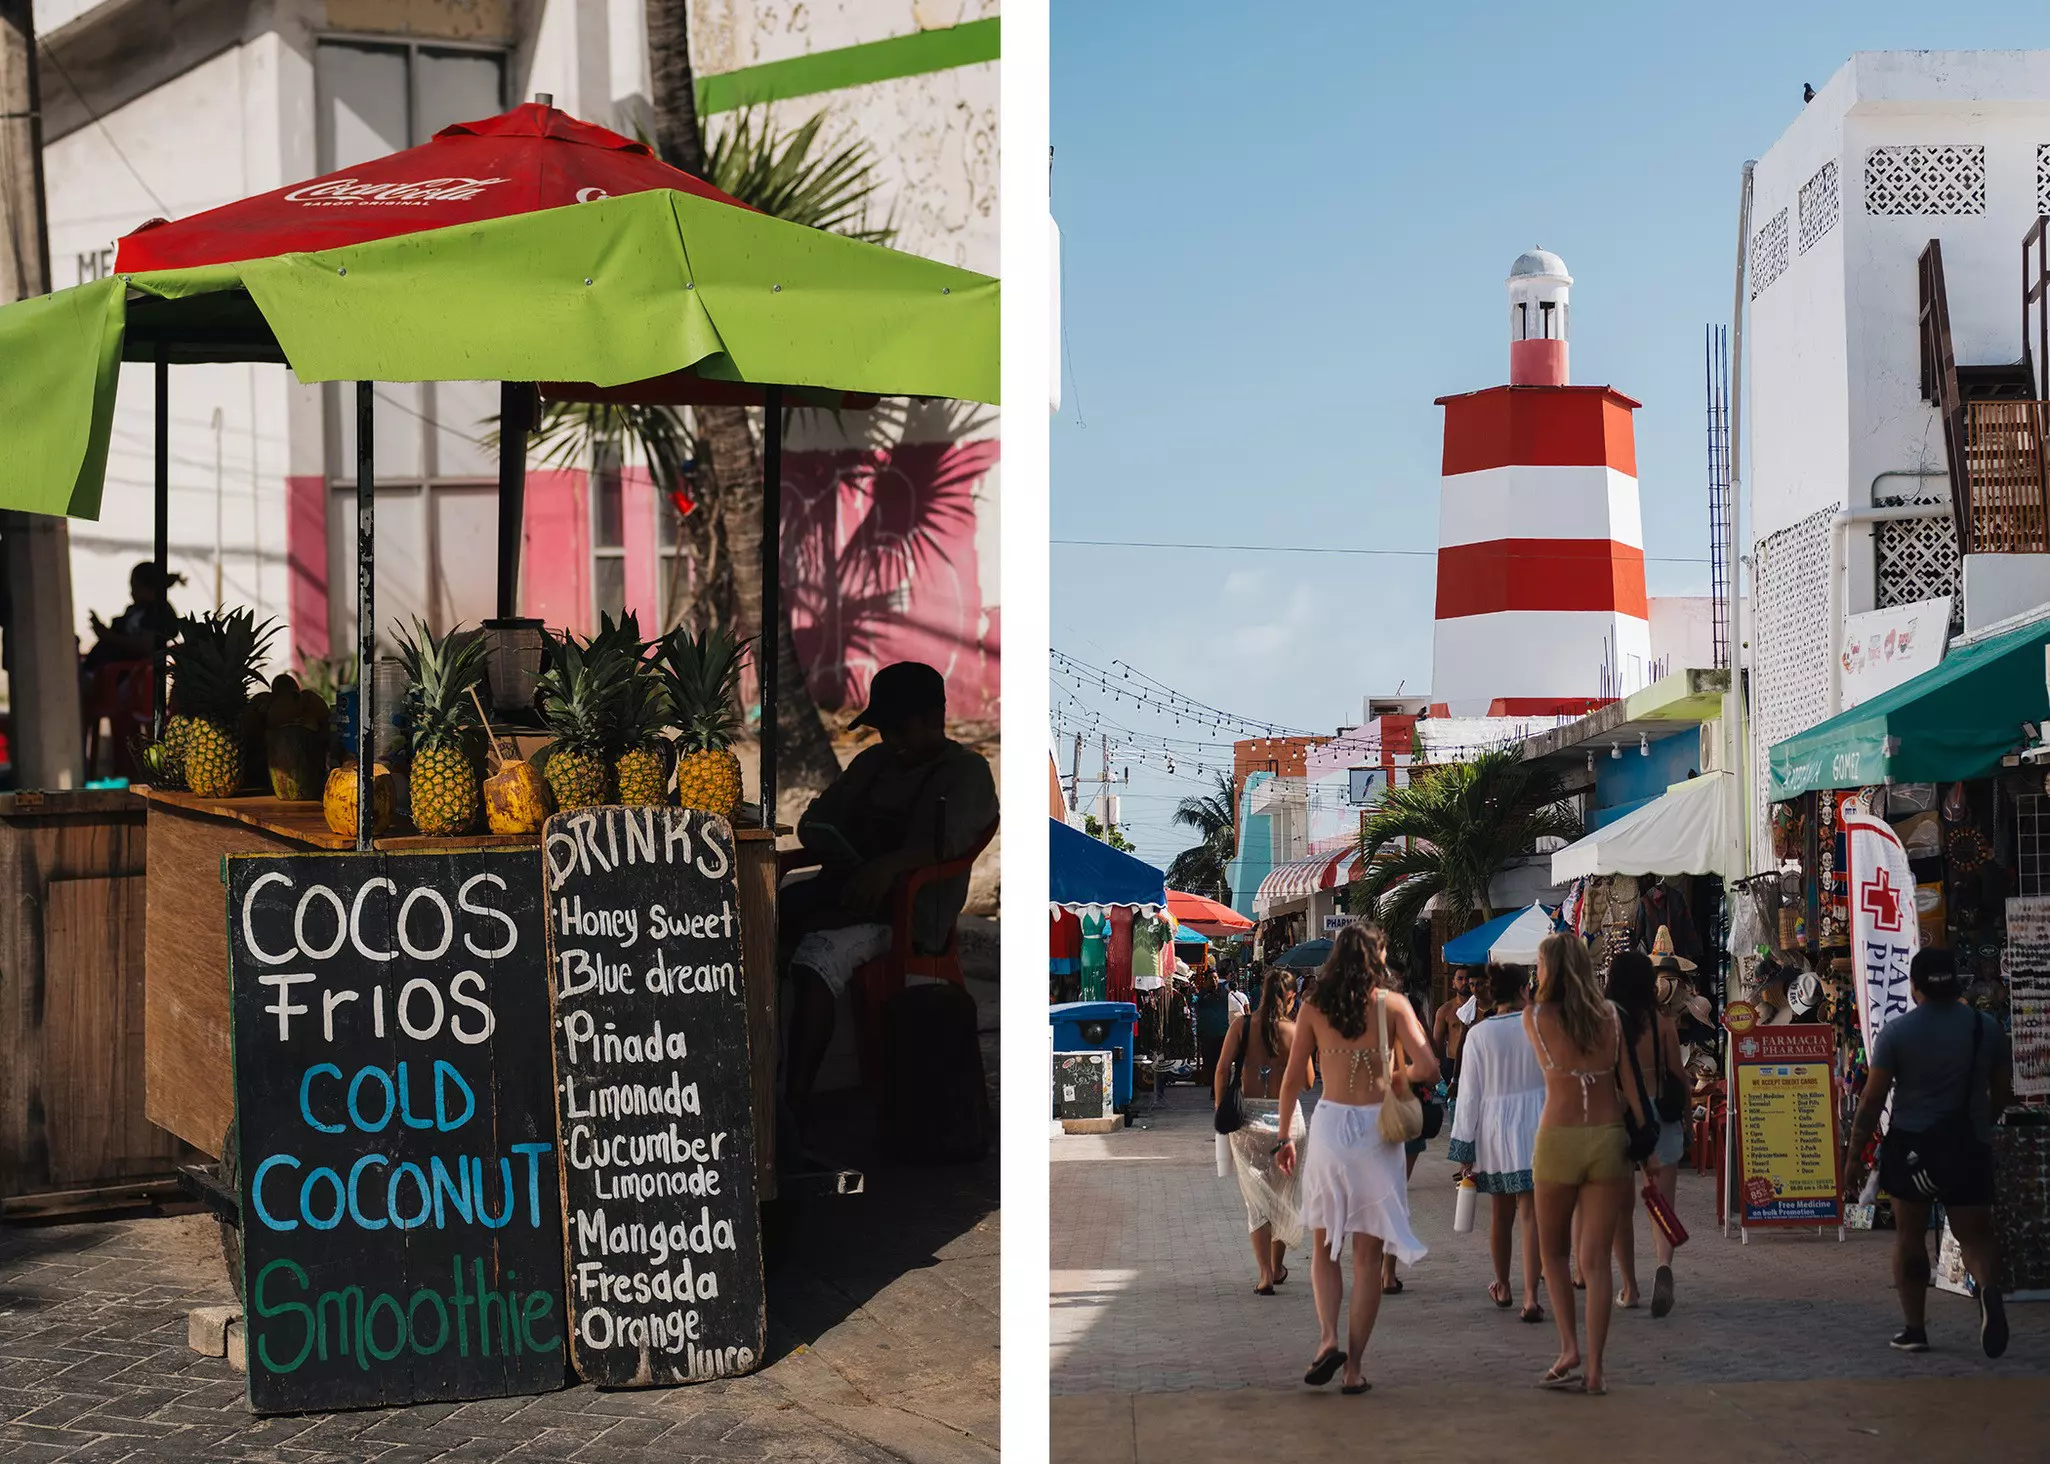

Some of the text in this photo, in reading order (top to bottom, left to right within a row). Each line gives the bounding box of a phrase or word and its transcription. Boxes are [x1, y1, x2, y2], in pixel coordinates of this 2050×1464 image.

[284, 177, 511, 201] Coca-Cola
[1832, 752, 1860, 781] GOMEZ
[546, 808, 728, 891] DRINKS
[242, 871, 518, 965] COCOS
[560, 895, 732, 948] Honey Sweet
[559, 948, 737, 999] Blue dream
[1884, 944, 1910, 1020] FAR
[563, 1010, 687, 1064] Piñada
[1761, 1035, 1827, 1046] FARMACIA
[1762, 1045, 1827, 1055] PHARMACY
[300, 1060, 475, 1133] COLD
[566, 1070, 701, 1121] Limonada
[570, 1123, 728, 1170] Cucumber
[252, 1142, 552, 1231] COCONUT
[595, 1164, 722, 1203] Limonade
[1778, 1201, 1795, 1209] Free
[577, 1206, 737, 1265] Mangada
[1779, 1208, 1815, 1216] Promotion
[576, 1257, 719, 1304] Fresada
[255, 1254, 562, 1374] Smoothie
[581, 1306, 701, 1354] Orange
[672, 1342, 754, 1382] Juice
